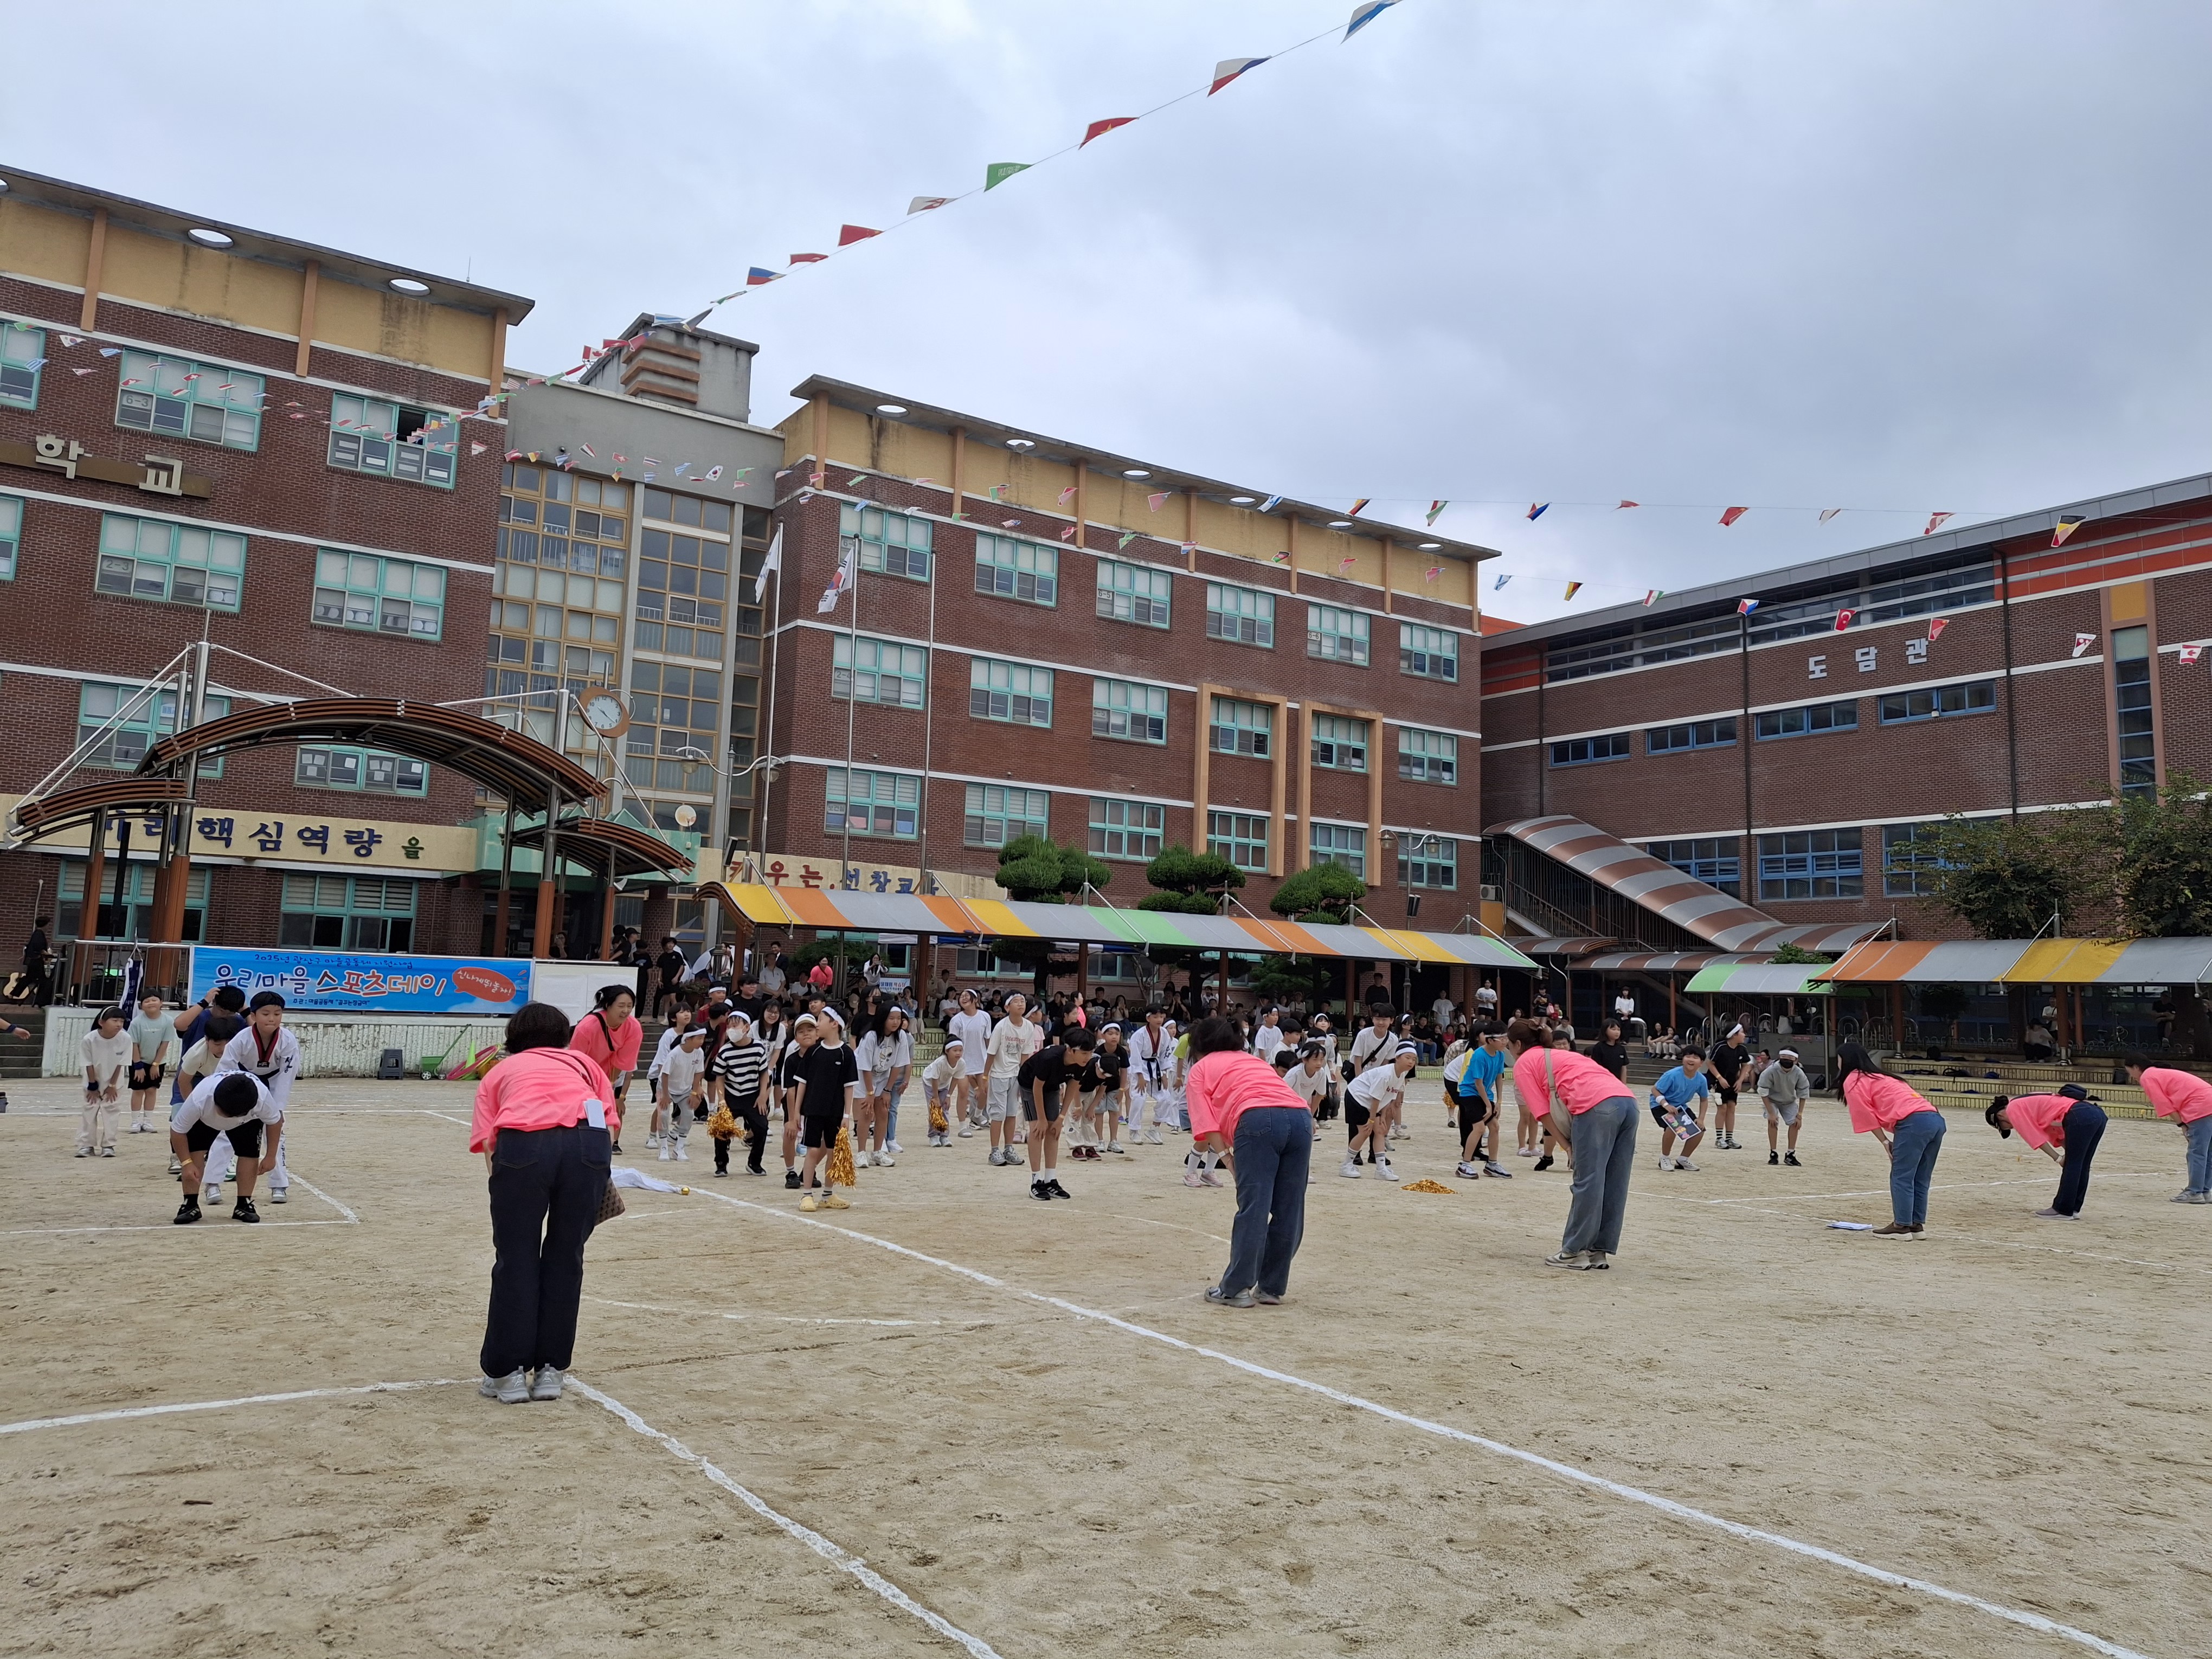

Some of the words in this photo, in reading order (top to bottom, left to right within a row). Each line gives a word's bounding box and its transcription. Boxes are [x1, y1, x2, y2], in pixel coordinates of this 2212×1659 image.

[126, 395, 149, 407] 6-3
[106, 559, 129, 571] 2-3
[1098, 590, 1111, 599] 6-5
[1309, 632, 1319, 640] 6-6
[1809, 638, 1928, 679] 도담관
[840, 867, 940, 896] 선창교
[254, 954, 290, 963] 2025년
[293, 955, 321, 965] 광산구
[325, 957, 371, 967] 마을공동체
[374, 960, 413, 969] 지원사업
[316, 969, 446, 996] 스포츠데이
